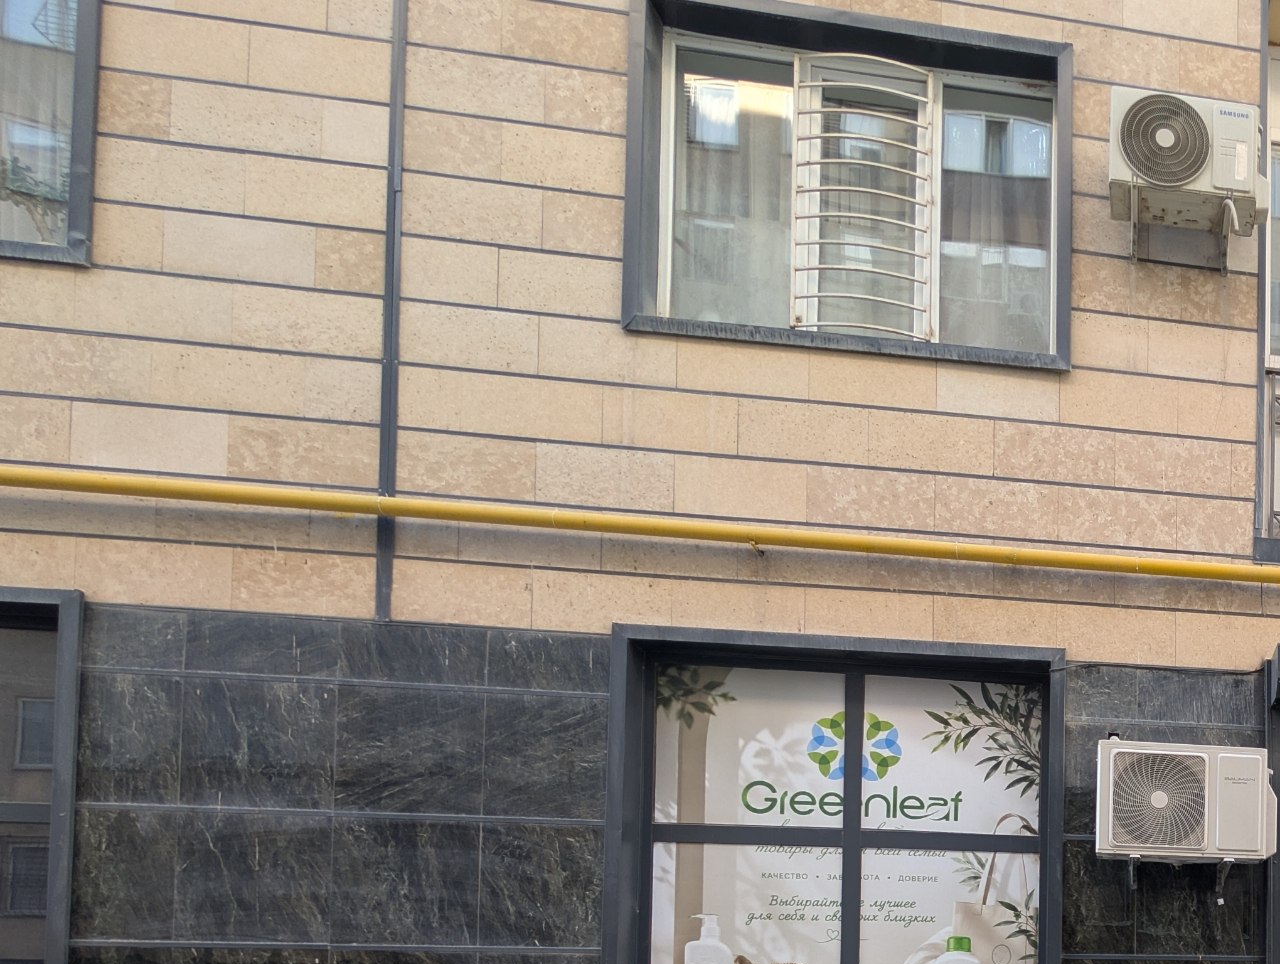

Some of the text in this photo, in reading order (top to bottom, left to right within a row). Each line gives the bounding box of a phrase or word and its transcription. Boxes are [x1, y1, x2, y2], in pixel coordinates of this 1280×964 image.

[1219, 109, 1249, 119] SAMSUNG
[741, 780, 964, 822] Greenleaf
[761, 872, 809, 881] КАЧЕСТВО
[898, 875, 939, 883] ДОВЕРИЕ
[869, 900, 917, 911] лучшее
[745, 912, 773, 926] для
[778, 909, 806, 921] себя
[883, 910, 936, 928] близких
